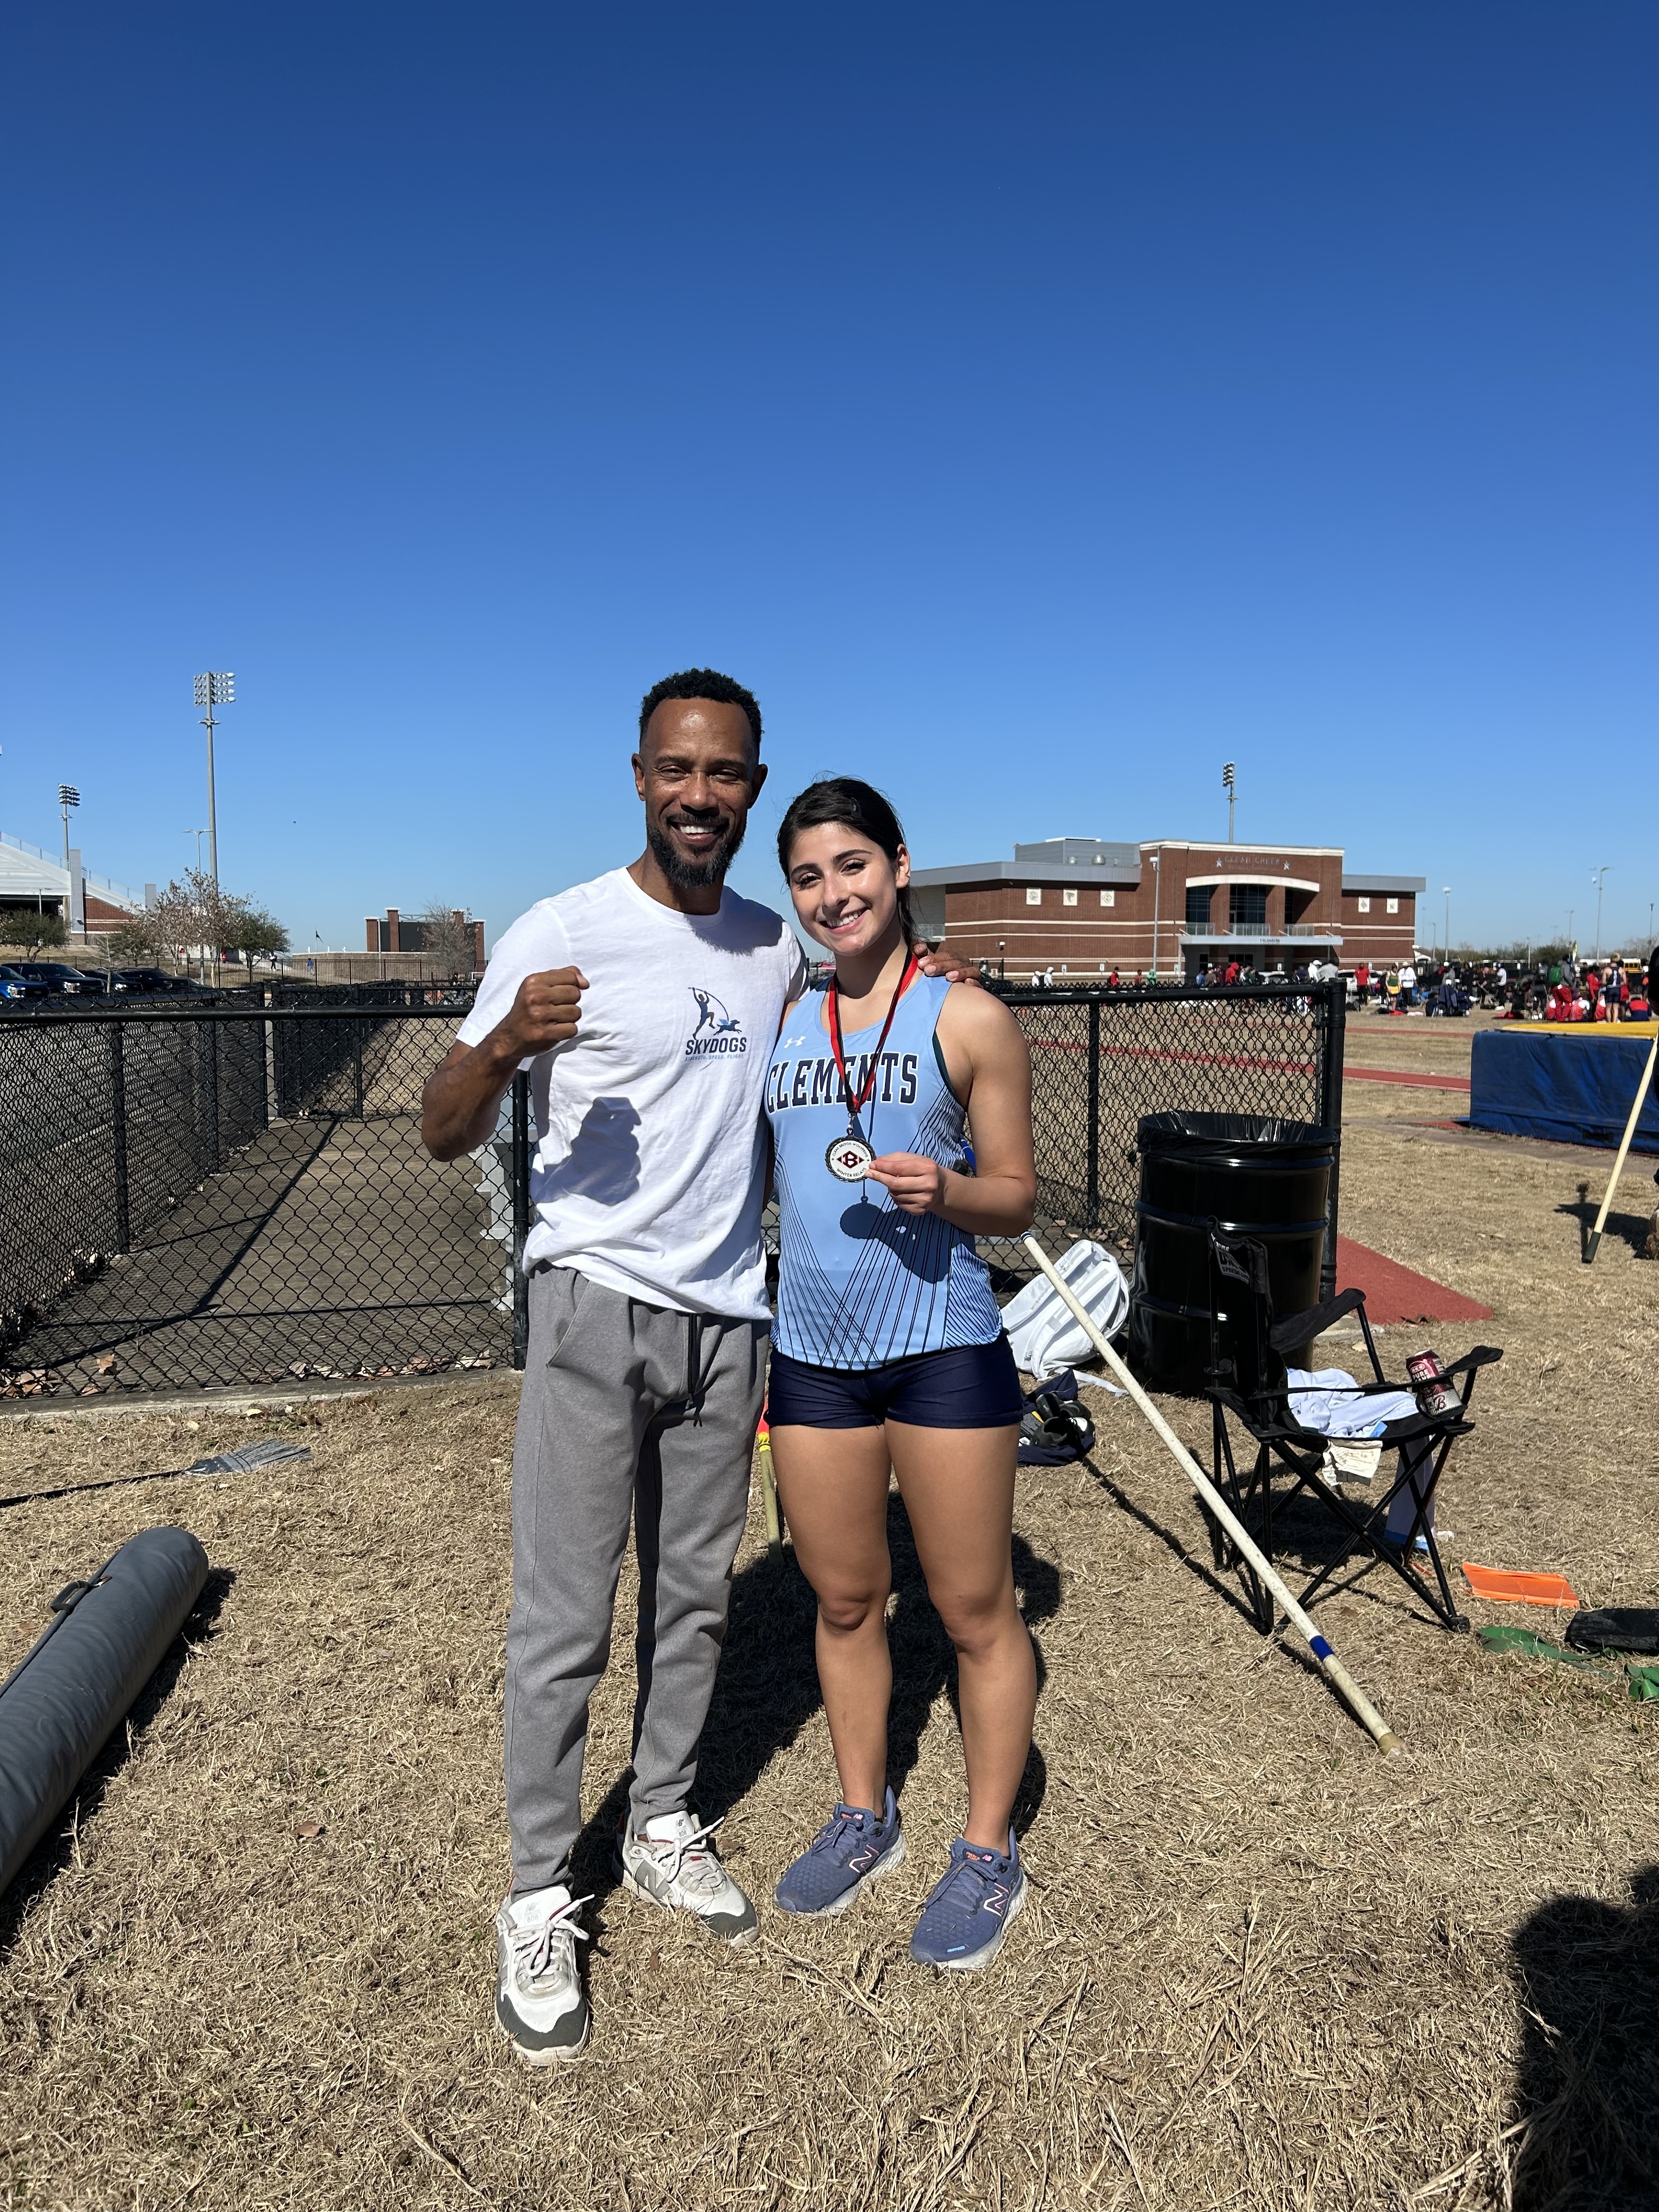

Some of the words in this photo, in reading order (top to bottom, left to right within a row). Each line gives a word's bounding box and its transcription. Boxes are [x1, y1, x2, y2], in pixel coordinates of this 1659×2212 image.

[685, 1037, 747, 1055] SKYDOGS
[768, 1052, 918, 1114] CLEMENTS
[1413, 1369, 1429, 1380] PURE
